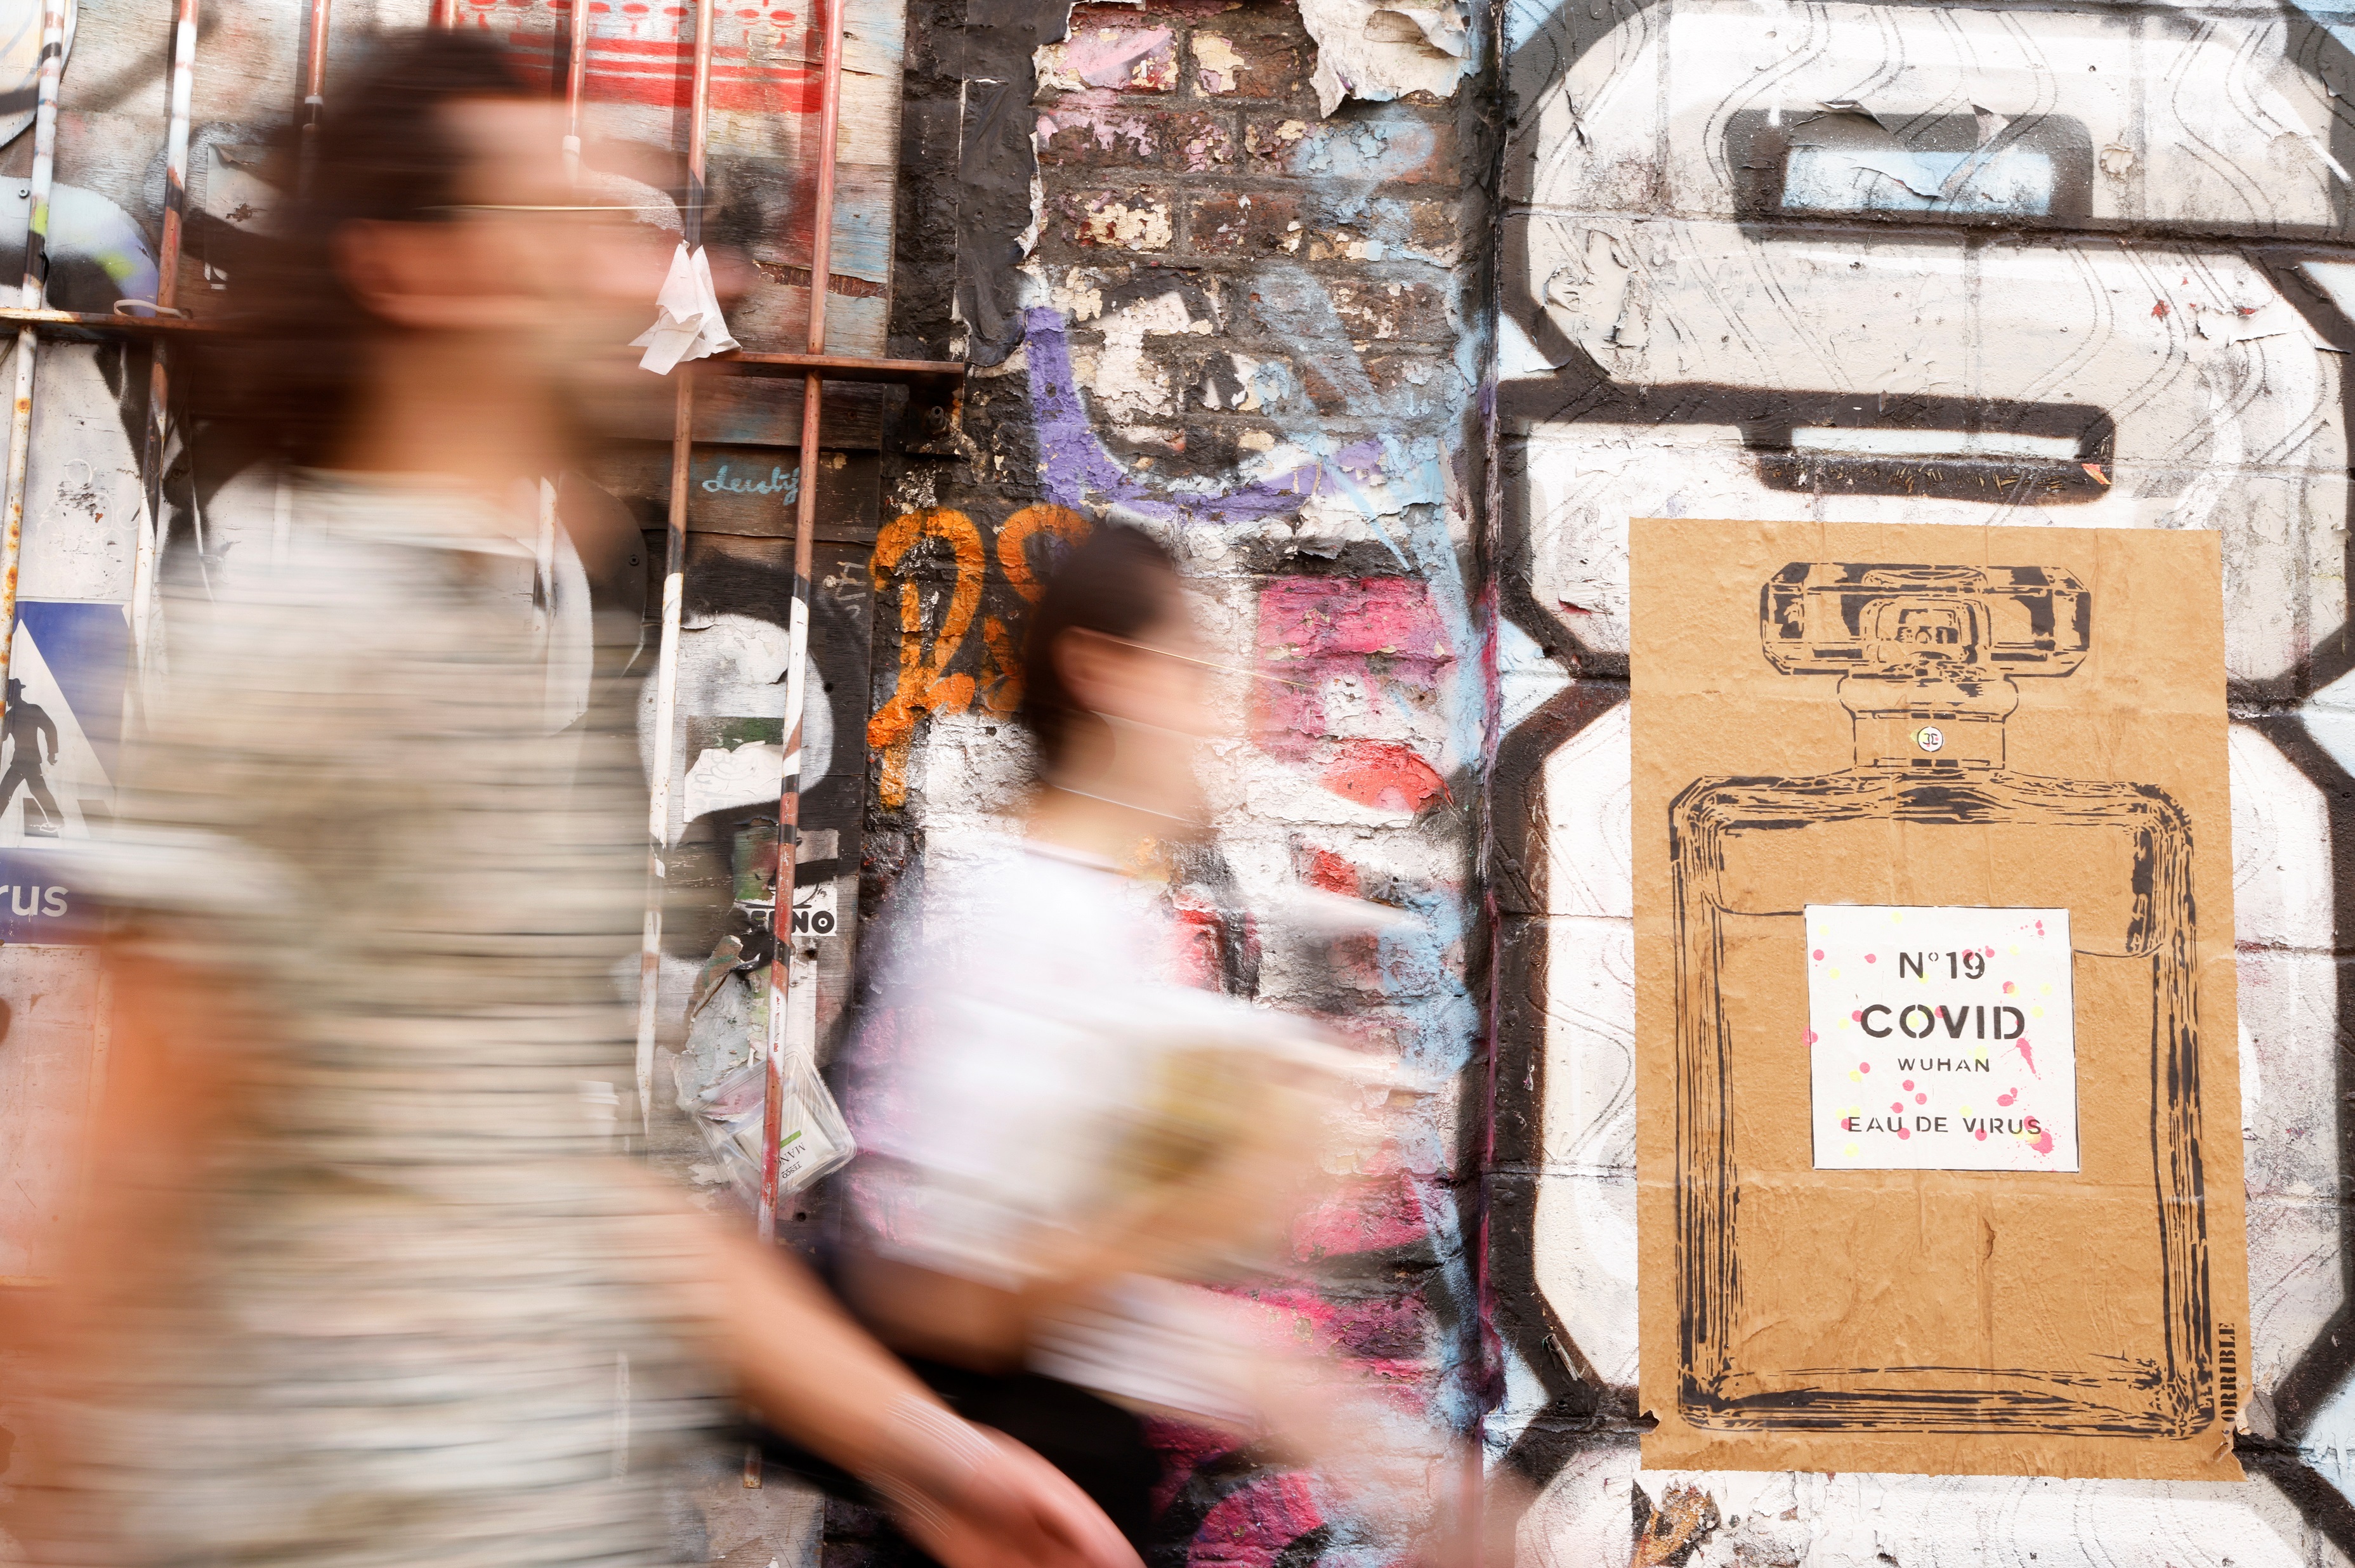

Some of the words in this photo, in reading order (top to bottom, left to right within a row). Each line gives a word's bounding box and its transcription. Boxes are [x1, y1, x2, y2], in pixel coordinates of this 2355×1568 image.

[1860, 1003, 2025, 1040] COVID
[1897, 1057, 1990, 1073] WUHAN
[1848, 1116, 1903, 1133] EAU
[1915, 1116, 1948, 1133] DE
[1962, 1117, 2042, 1135] VIRUS
[782, 1163, 803, 1179] TESCO
